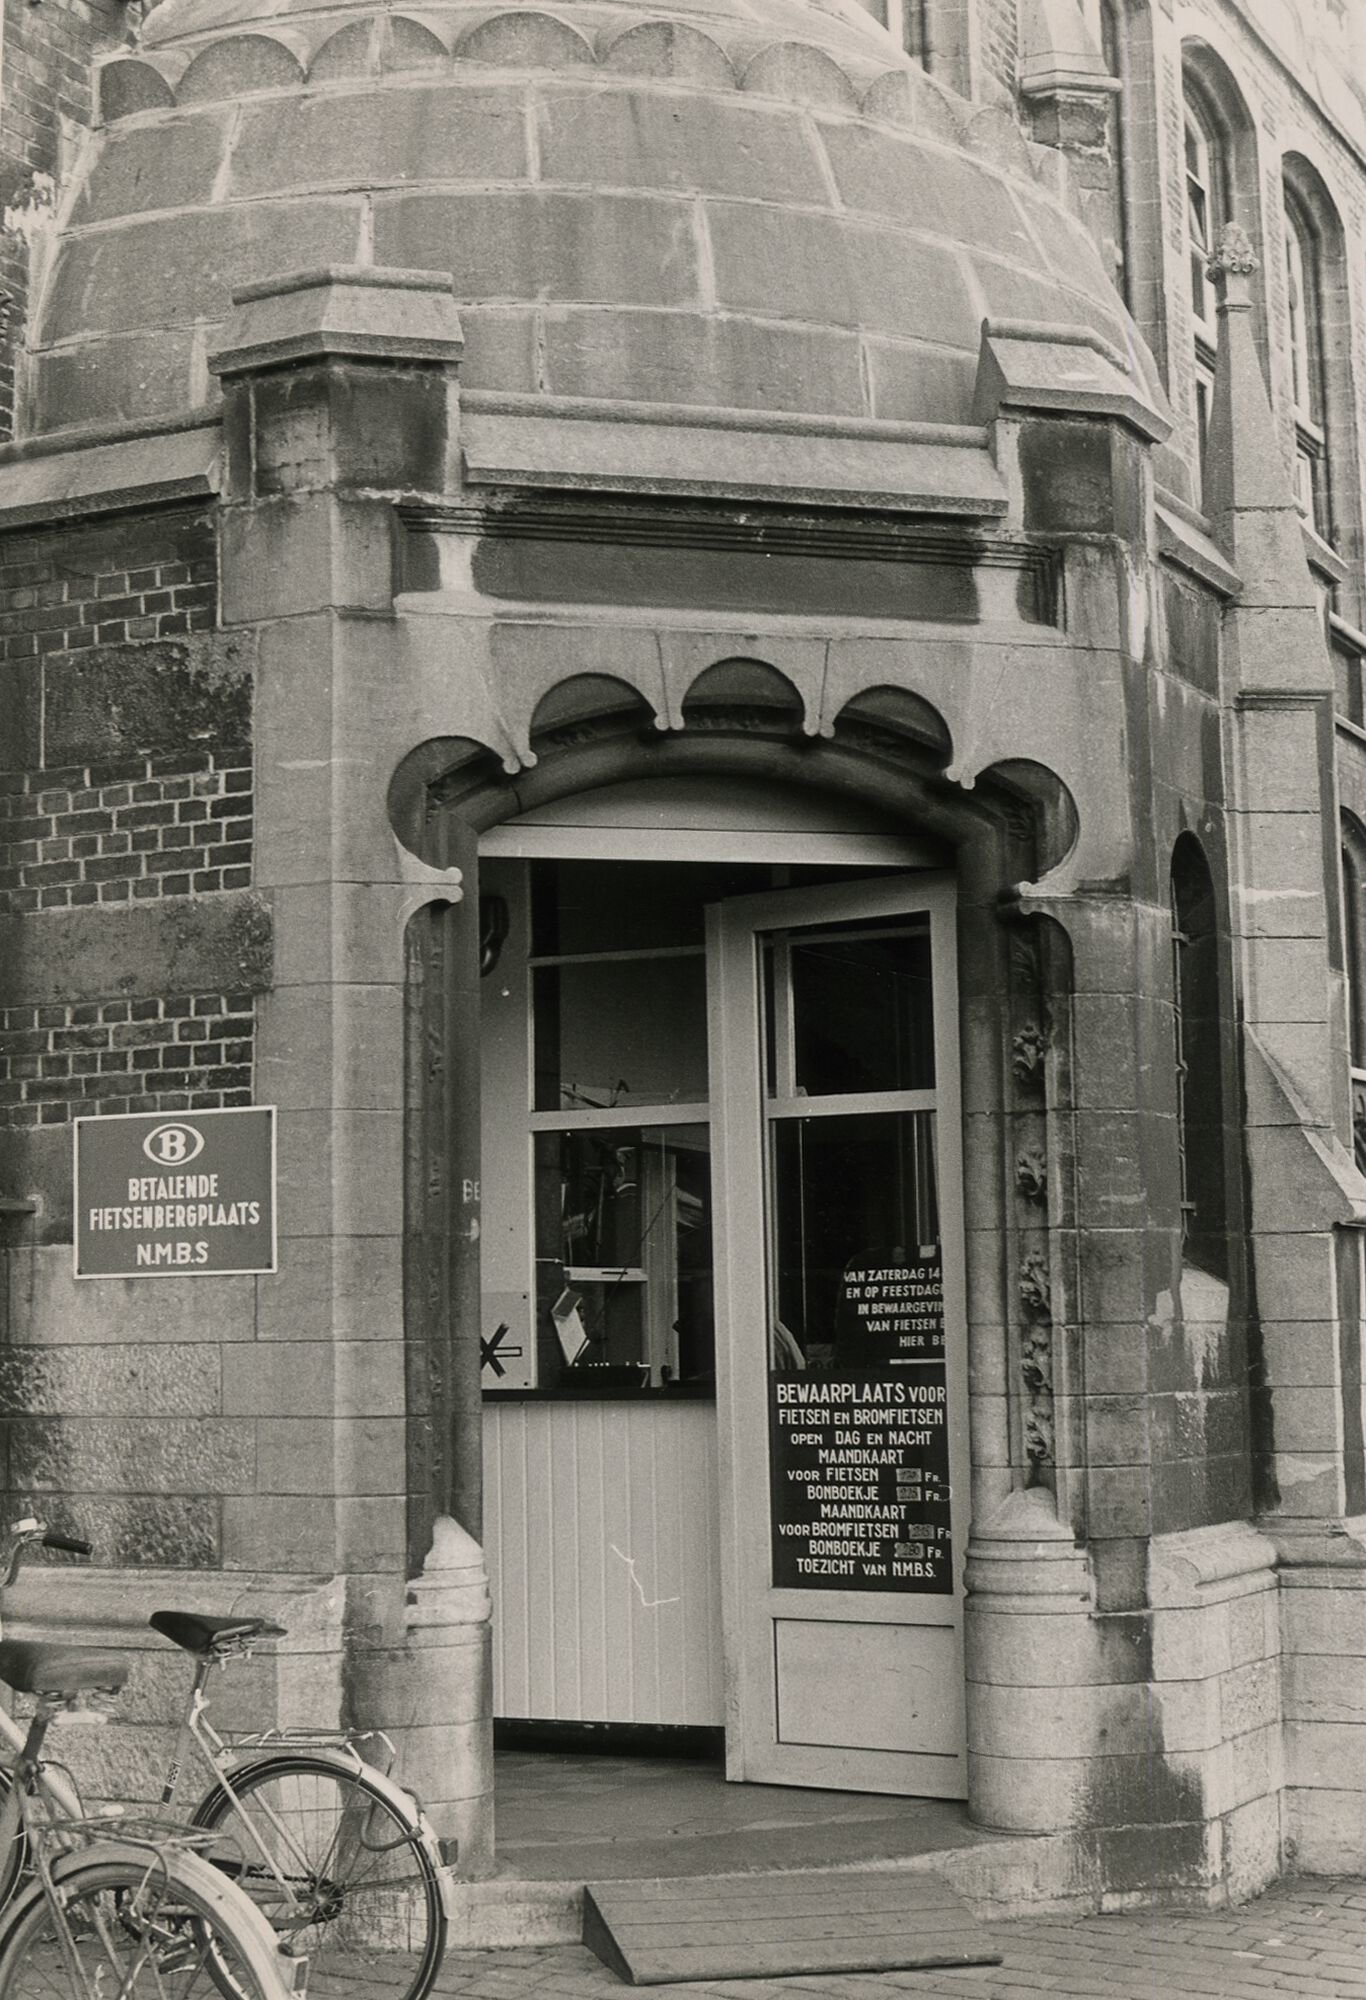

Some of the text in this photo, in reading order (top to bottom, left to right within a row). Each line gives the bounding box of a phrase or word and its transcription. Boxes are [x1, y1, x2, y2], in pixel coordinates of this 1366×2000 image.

[158, 1129, 187, 1161] B
[128, 1174, 219, 1201] BETALENDE
[89, 1201, 261, 1231] FIETSENBERGPLAATS
[137, 1241, 209, 1266] N.M.B.S
[867, 1267, 926, 1282] ZATERDAG
[846, 1287, 861, 1299] EN
[864, 1285, 880, 1299] OP
[858, 1303, 870, 1315] IN
[866, 1320, 891, 1332] VAN
[894, 1318, 938, 1331] FIETSEN
[899, 1335, 925, 1347] HIER
[776, 1383, 946, 1404] BEWAARPLAATS VOOR
[779, 1408, 943, 1425] FIETSEN EN BROMFIETSEN
[790, 1430, 933, 1445] OPEN DAG EN NACHT
[818, 1449, 905, 1465] MAANDKAART
[787, 1469, 820, 1481] VOOR
[826, 1467, 879, 1482] FIETSEN
[807, 1485, 880, 1501] BONBOEKJE
[820, 1503, 907, 1520] MAANDKAART
[779, 1523, 810, 1537] VOOR
[811, 1522, 900, 1540] BROMFIETSEN
[808, 1539, 881, 1558] BONBOEKJE
[796, 1558, 856, 1575] TOEZICHT
[862, 1562, 886, 1576] VAN
